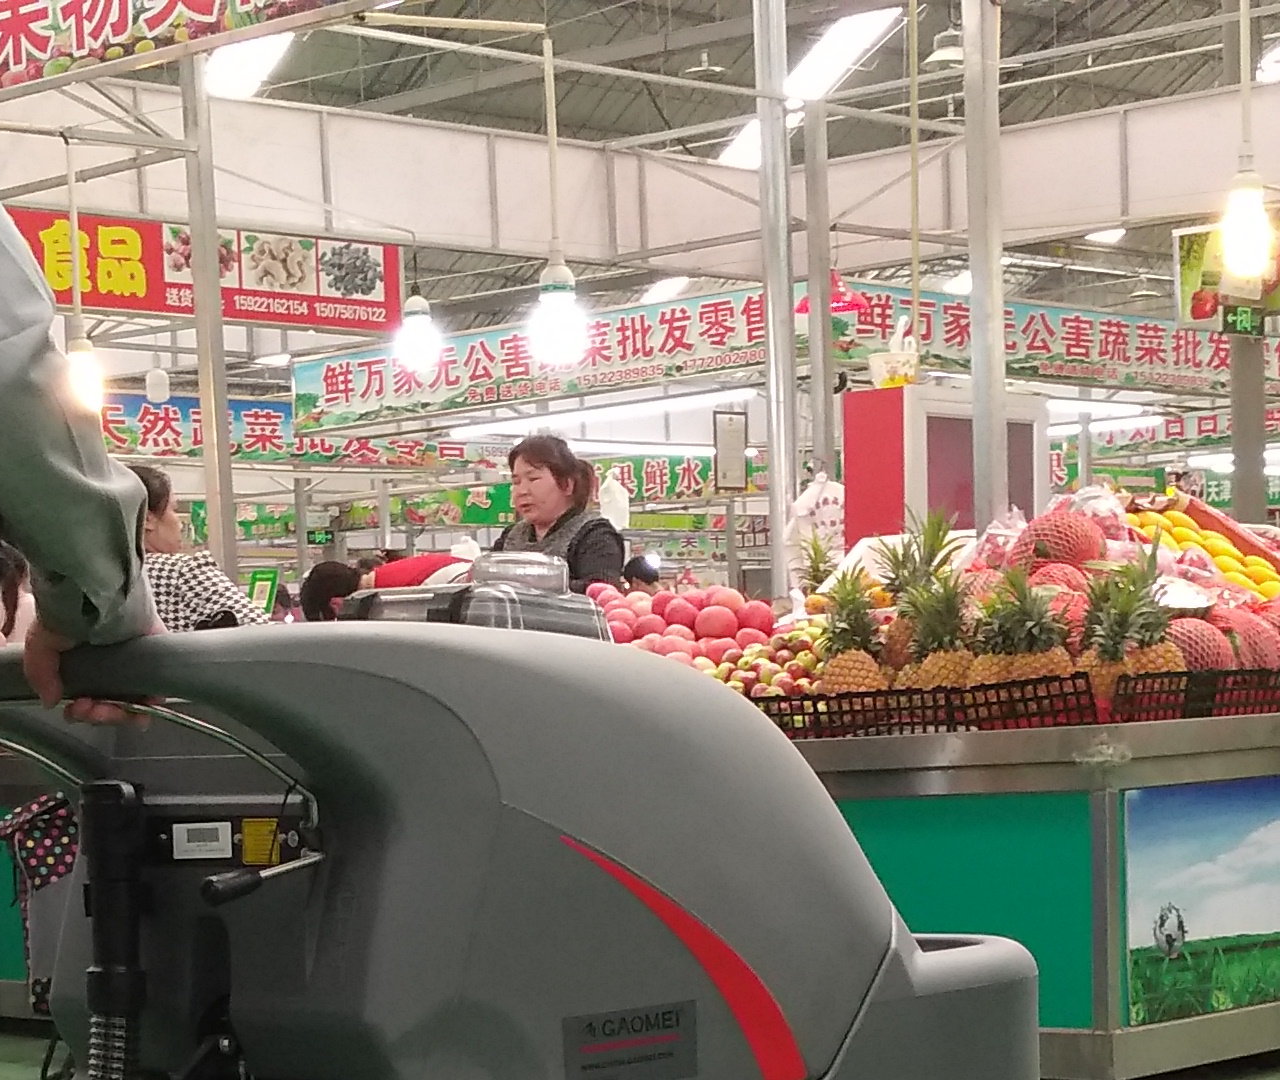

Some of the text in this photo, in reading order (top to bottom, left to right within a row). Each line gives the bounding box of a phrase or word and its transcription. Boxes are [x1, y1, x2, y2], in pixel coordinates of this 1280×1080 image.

[39, 219, 146, 297] 食品
[233, 295, 308, 315] 15922162154
[314, 303, 386, 322] 15075876122
[322, 292, 765, 406] 鲜万家无公害菜批发零售
[468, 378, 561, 402] 免费送货电话
[682, 349, 766, 372] 1772002780
[601, 1010, 681, 1038] GAOMEI
